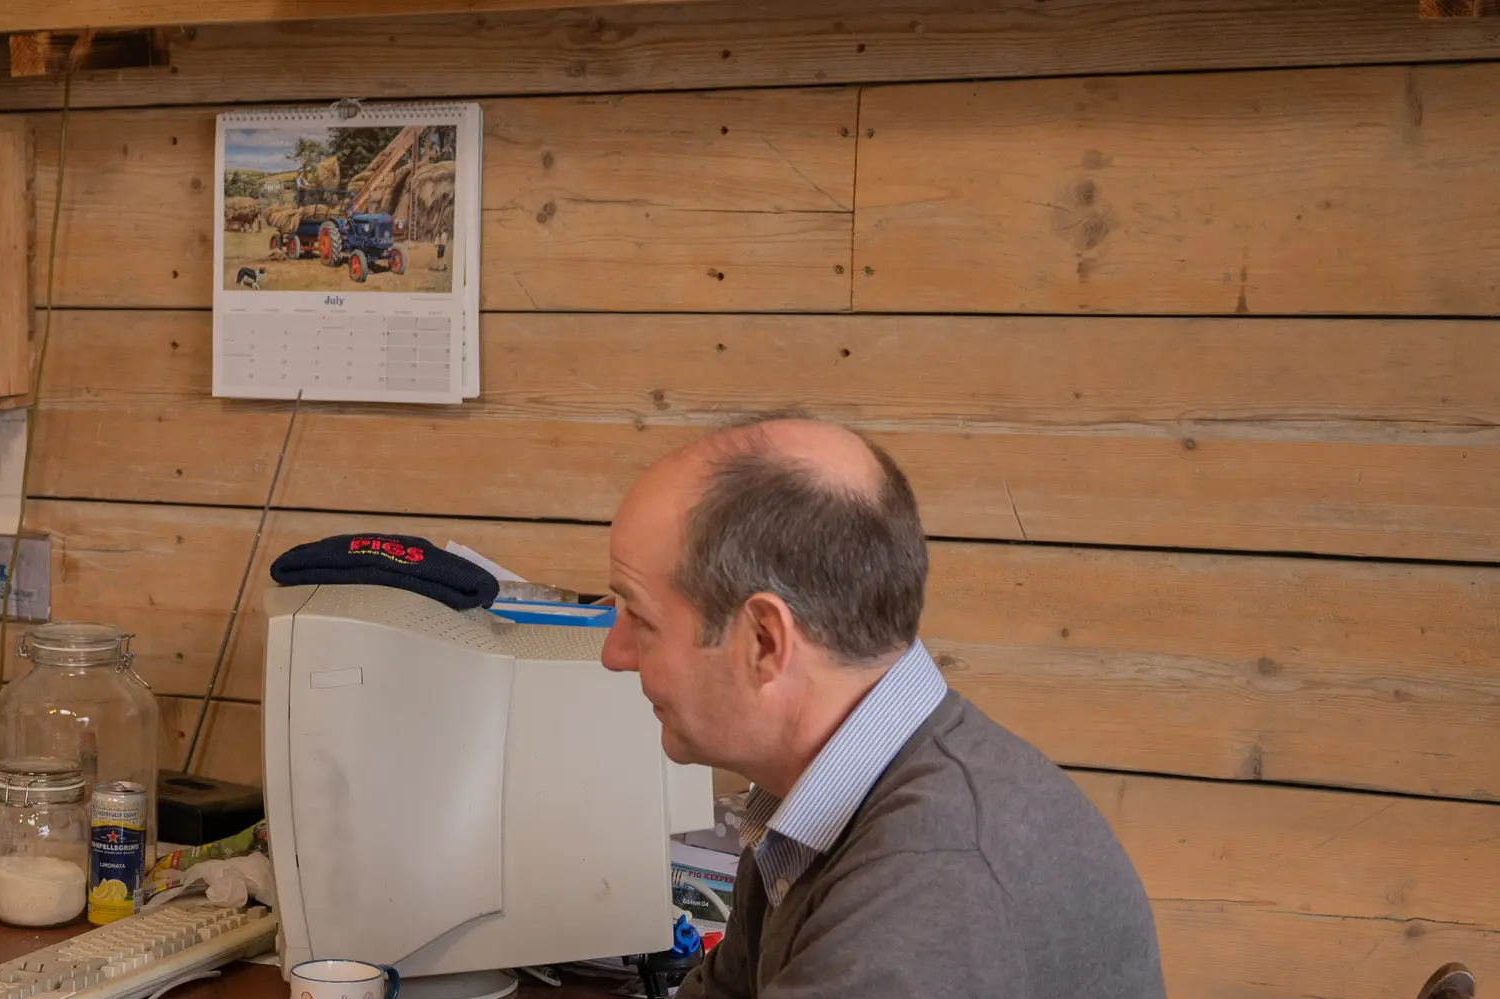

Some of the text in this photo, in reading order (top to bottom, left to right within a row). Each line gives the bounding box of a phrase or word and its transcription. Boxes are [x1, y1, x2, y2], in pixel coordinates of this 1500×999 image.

[324, 295, 345, 306] July
[350, 539, 424, 562] PIGS
[688, 871, 702, 879] PIG
[683, 898, 701, 906] Edition
